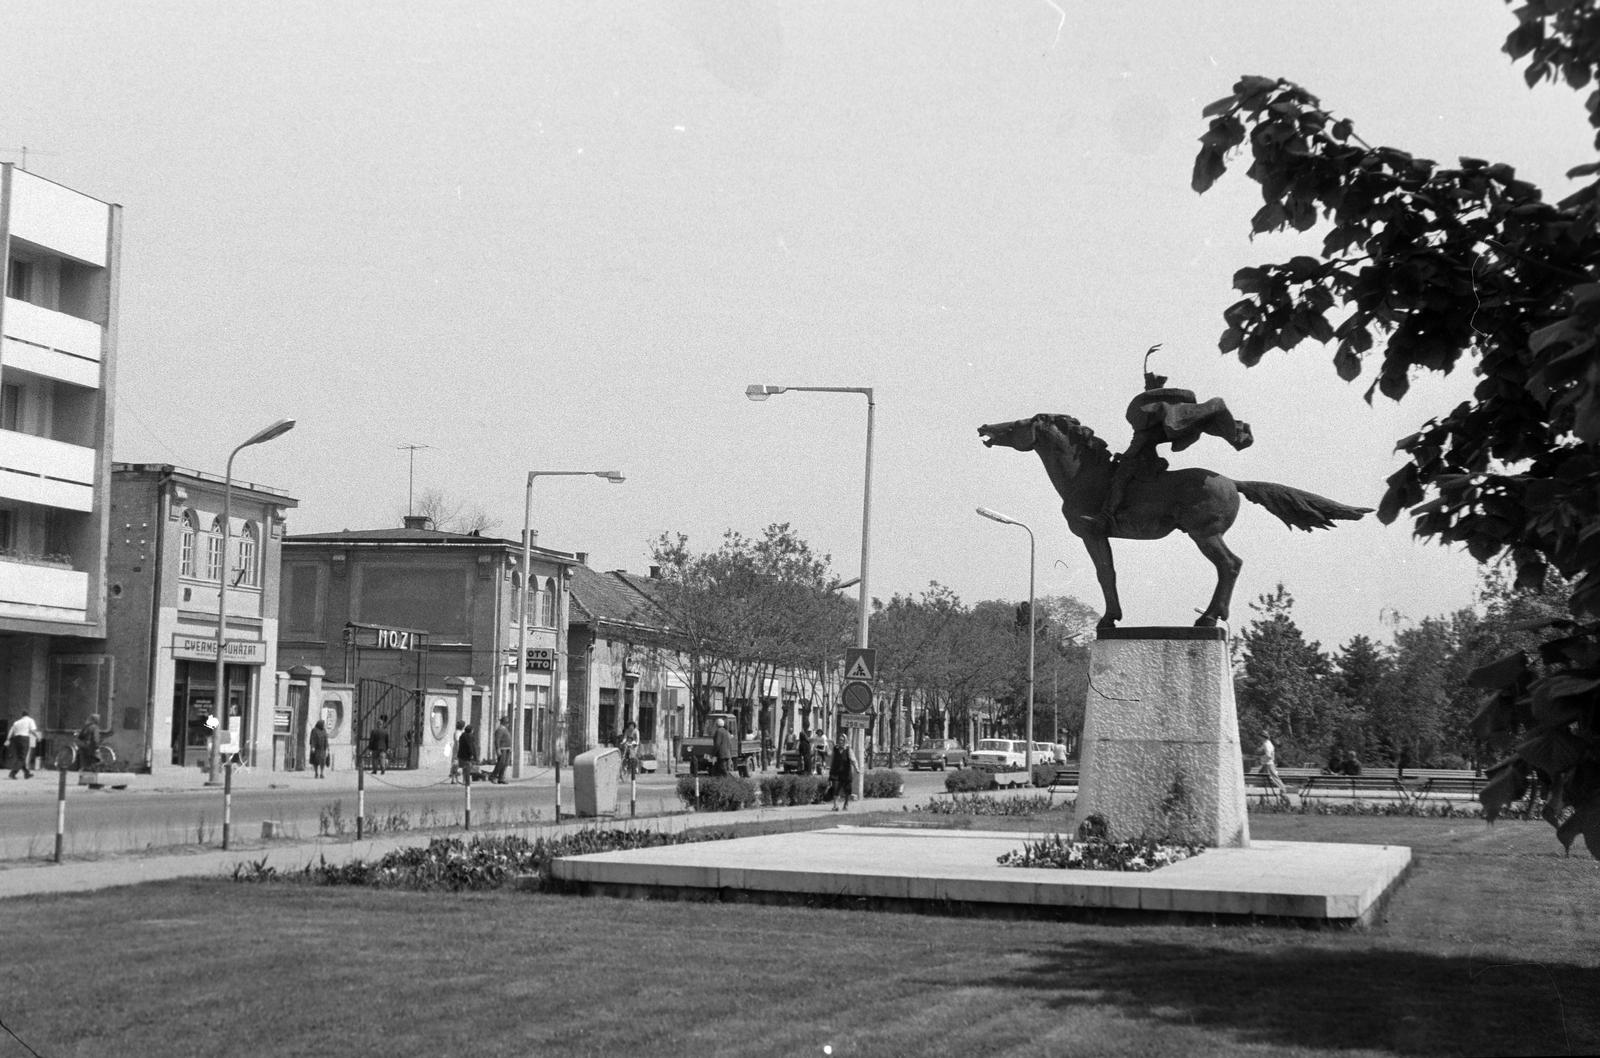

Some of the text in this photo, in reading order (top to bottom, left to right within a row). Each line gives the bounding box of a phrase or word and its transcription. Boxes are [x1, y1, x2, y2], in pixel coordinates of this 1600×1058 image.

[378, 629, 414, 651] MOZI
[527, 650, 547, 658] OTO
[526, 660, 549, 669] TTO
